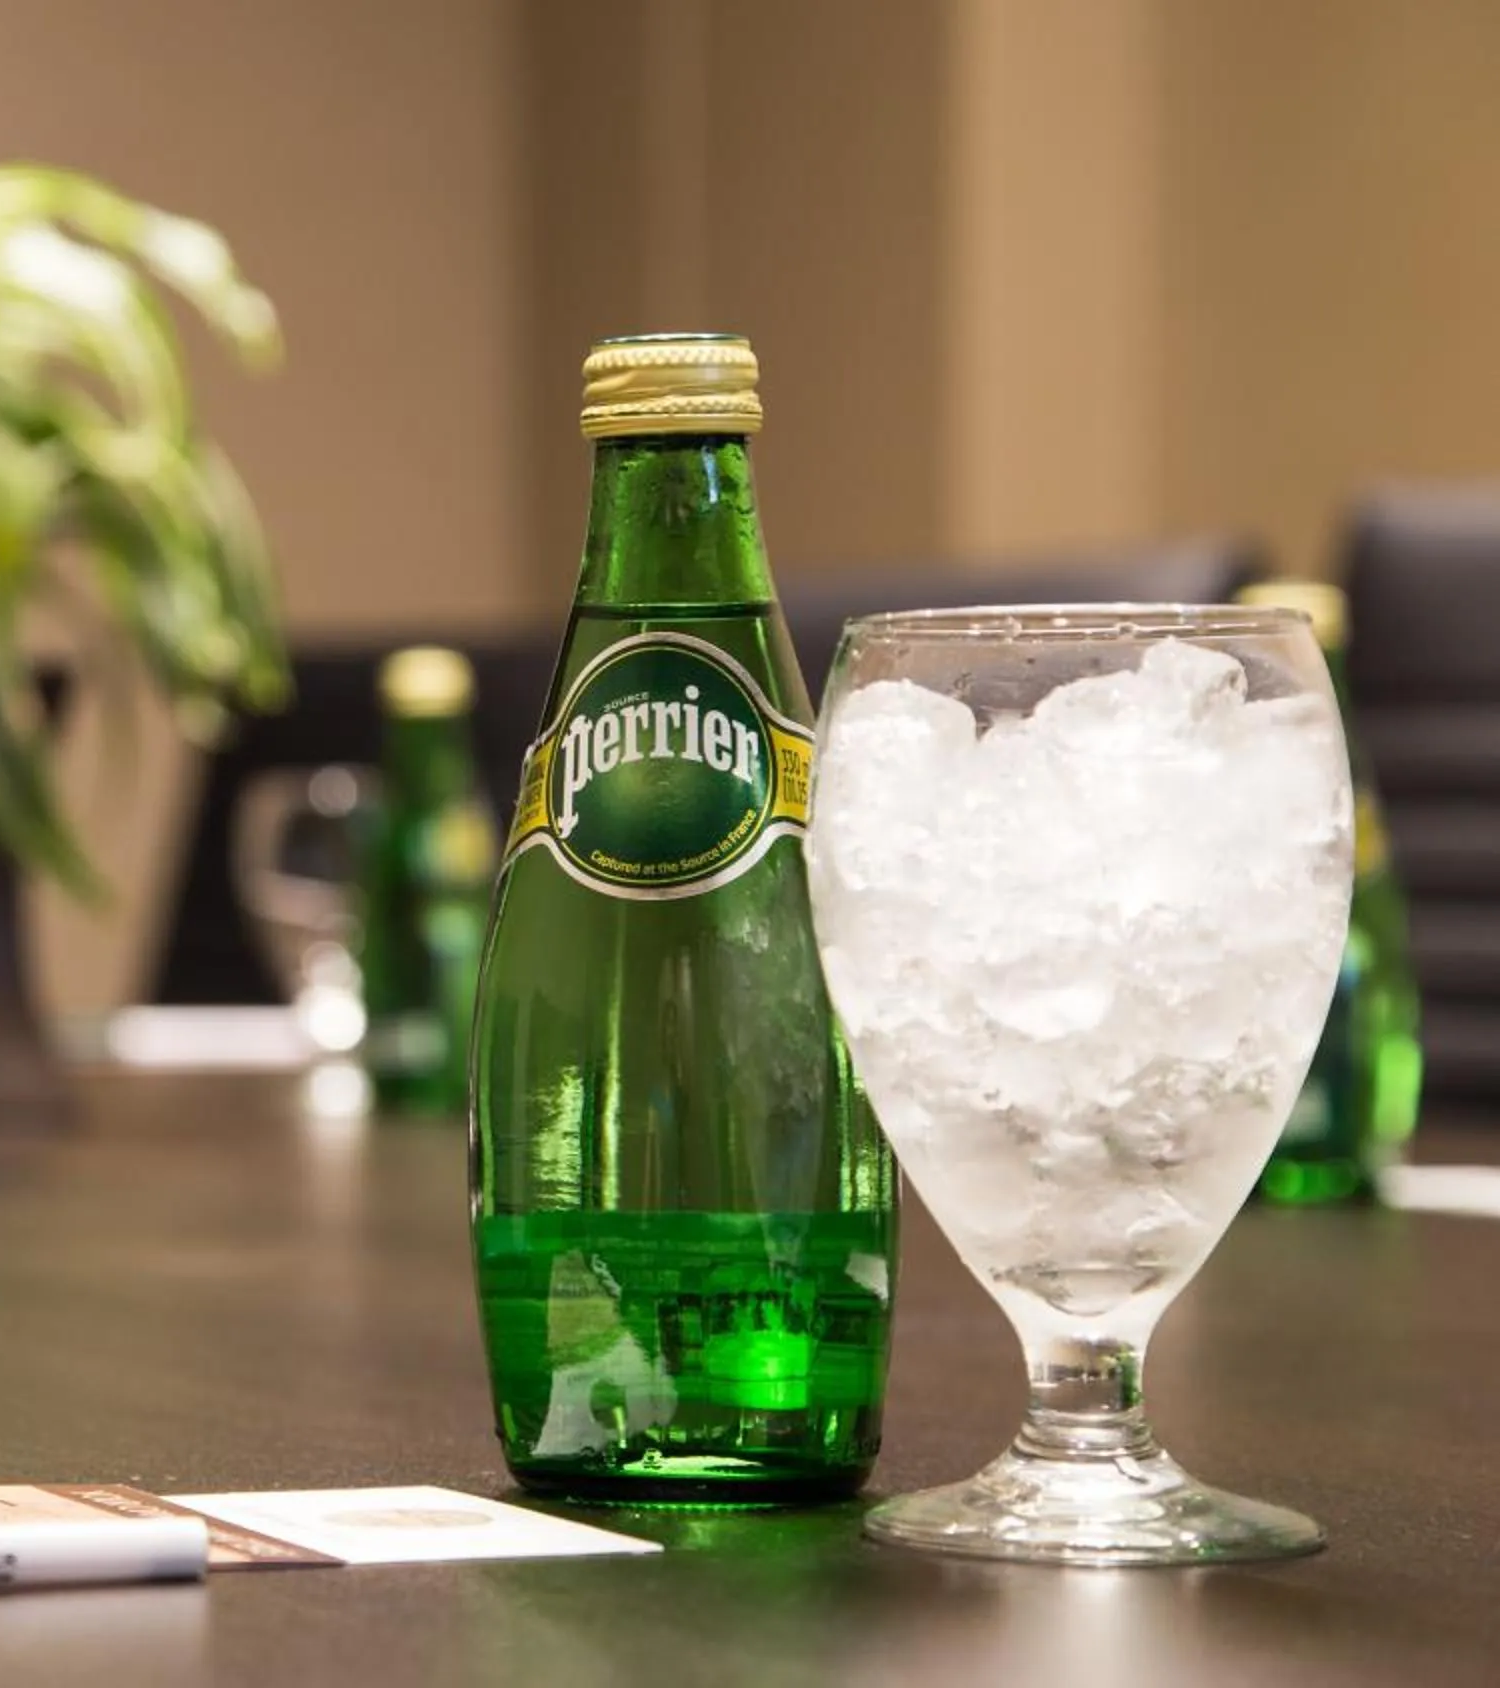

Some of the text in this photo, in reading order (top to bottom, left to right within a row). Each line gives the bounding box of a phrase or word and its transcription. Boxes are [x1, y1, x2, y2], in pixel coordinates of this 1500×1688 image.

[603, 691, 649, 712] SOURCE
[591, 850, 641, 874] Captured
[643, 864, 655, 875] at
[658, 862, 678, 873] the
[680, 847, 720, 870] Source
[728, 808, 756, 843] France
